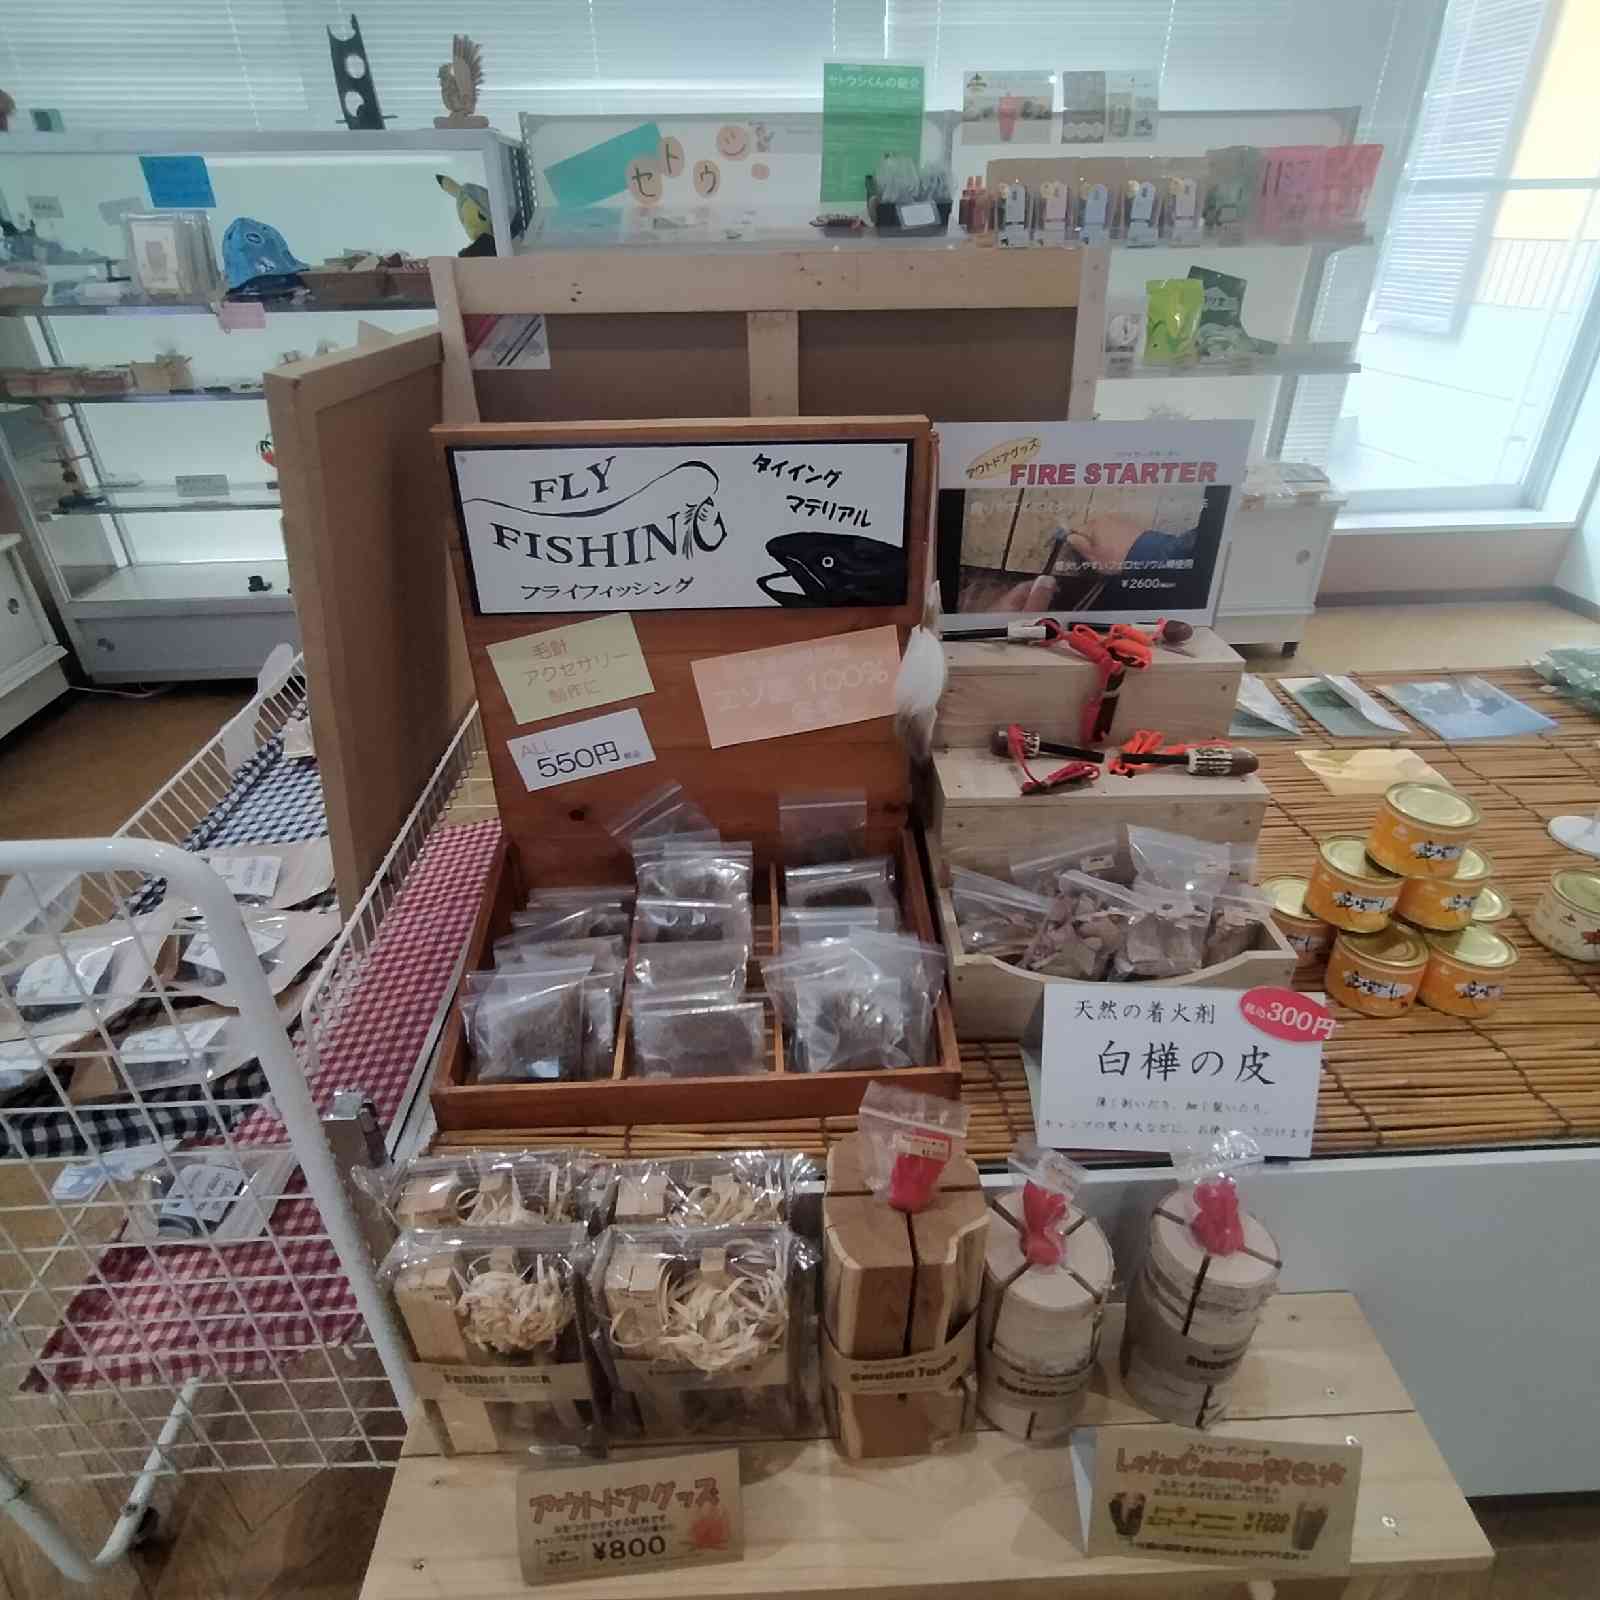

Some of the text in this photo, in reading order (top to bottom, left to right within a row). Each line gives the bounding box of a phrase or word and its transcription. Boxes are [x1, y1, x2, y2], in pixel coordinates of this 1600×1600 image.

[752, 453, 843, 489] タイイング
[965, 437, 1041, 479] アウトドアグッズ
[1009, 462, 1218, 486] FIRE STARTER
[531, 456, 618, 503] FLY
[786, 494, 873, 528] マテリアル
[488, 496, 728, 568] FISHING
[520, 576, 695, 601] フライフィッシング
[522, 652, 631, 687] アクセサリー
[804, 658, 889, 695] 100%
[537, 740, 621, 778] 550円
[1074, 999, 1217, 1025] 天然の着火剤
[1097, 1040, 1276, 1085] 白樺の皮
[529, 1476, 720, 1525] アウトドアグッズ
[592, 1535, 667, 1562] ¥800
